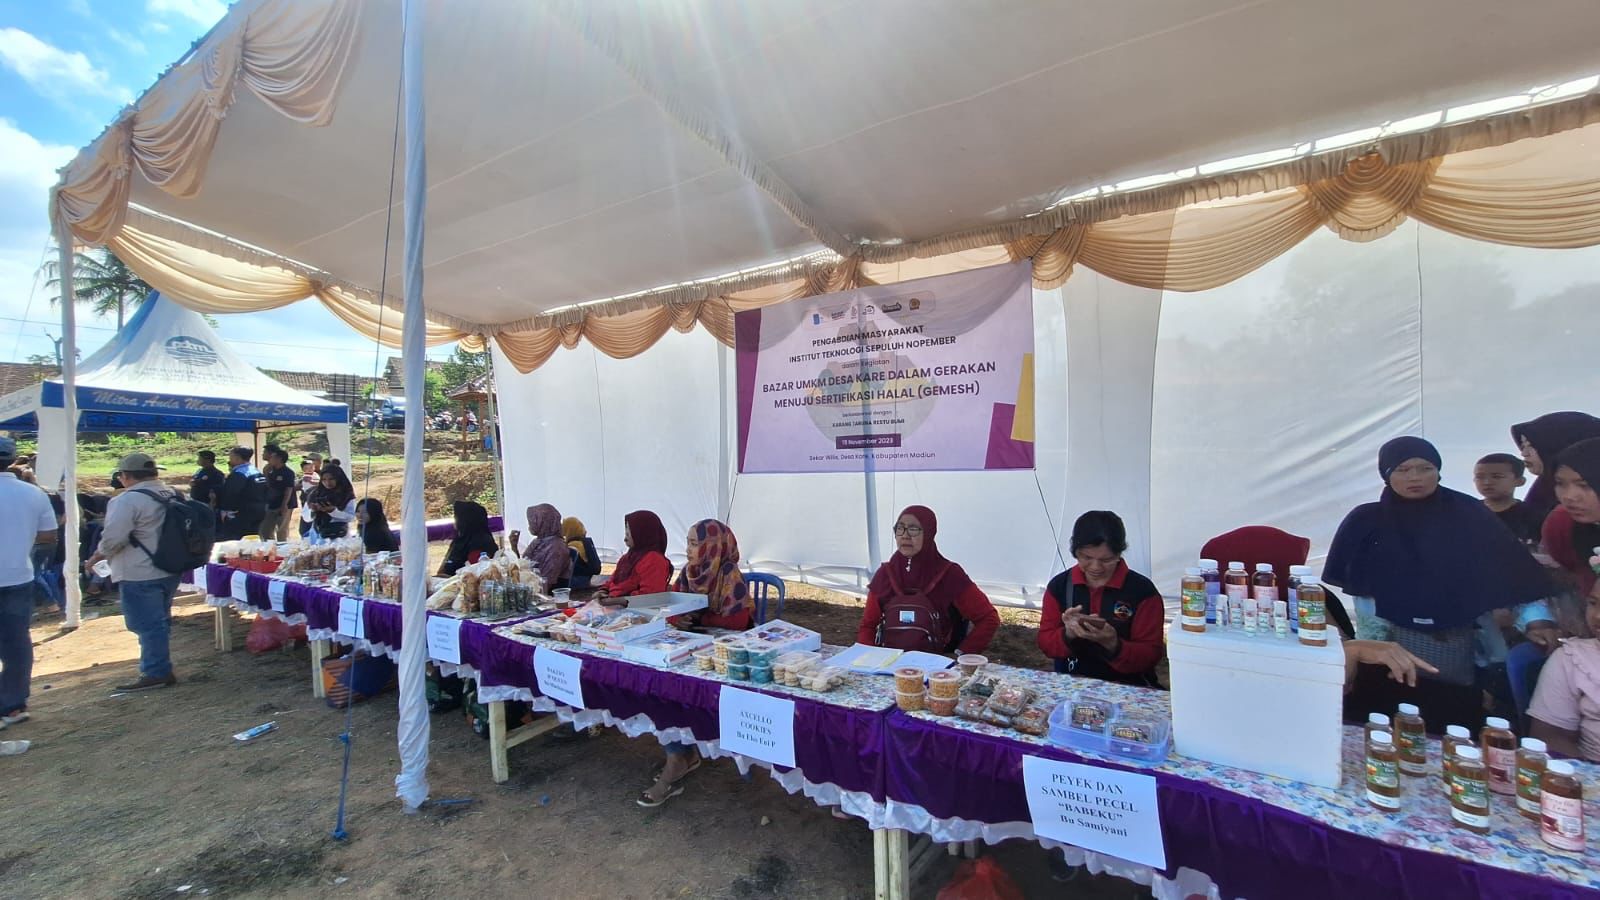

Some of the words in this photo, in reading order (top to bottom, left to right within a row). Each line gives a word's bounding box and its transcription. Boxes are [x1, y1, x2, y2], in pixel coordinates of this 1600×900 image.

[812, 333, 861, 347] PENGABDIAN
[861, 325, 924, 340] MASYARAKAT
[789, 352, 820, 363] INSTITUT
[822, 344, 864, 359] TEKNOLOGI
[865, 342, 904, 353] SEPULUH
[906, 336, 957, 349] NOPEMBER
[763, 381, 794, 393] BAZAR
[795, 378, 826, 389] UMKM
[828, 375, 854, 386] DESA
[855, 371, 885, 384] KARE
[888, 367, 931, 380] DALAM
[934, 361, 996, 376] GERAKAN
[92, 389, 138, 406] Mitra
[141, 395, 180, 408] Anda
[184, 397, 231, 414] Menuju
[235, 402, 270, 414] Sehat
[272, 404, 320, 418] Sejahtera
[774, 397, 814, 409] MENUJU
[815, 390, 874, 405] SERTIFIKASI
[877, 388, 915, 400] HALAL
[918, 380, 980, 399] (GEMESH)
[848, 438, 877, 446] November
[871, 452, 908, 460] Kabupaten
[909, 451, 936, 459] Madiun
[740, 721, 771, 735] COOKIES
[1051, 773, 1092, 790] PEYEK
[1096, 781, 1124, 795] DAN
[1041, 785, 1092, 804] SAMBEL
[1095, 796, 1138, 813] PECEL
[1060, 814, 1075, 824] Bu
[1077, 818, 1128, 837] Samiyani
